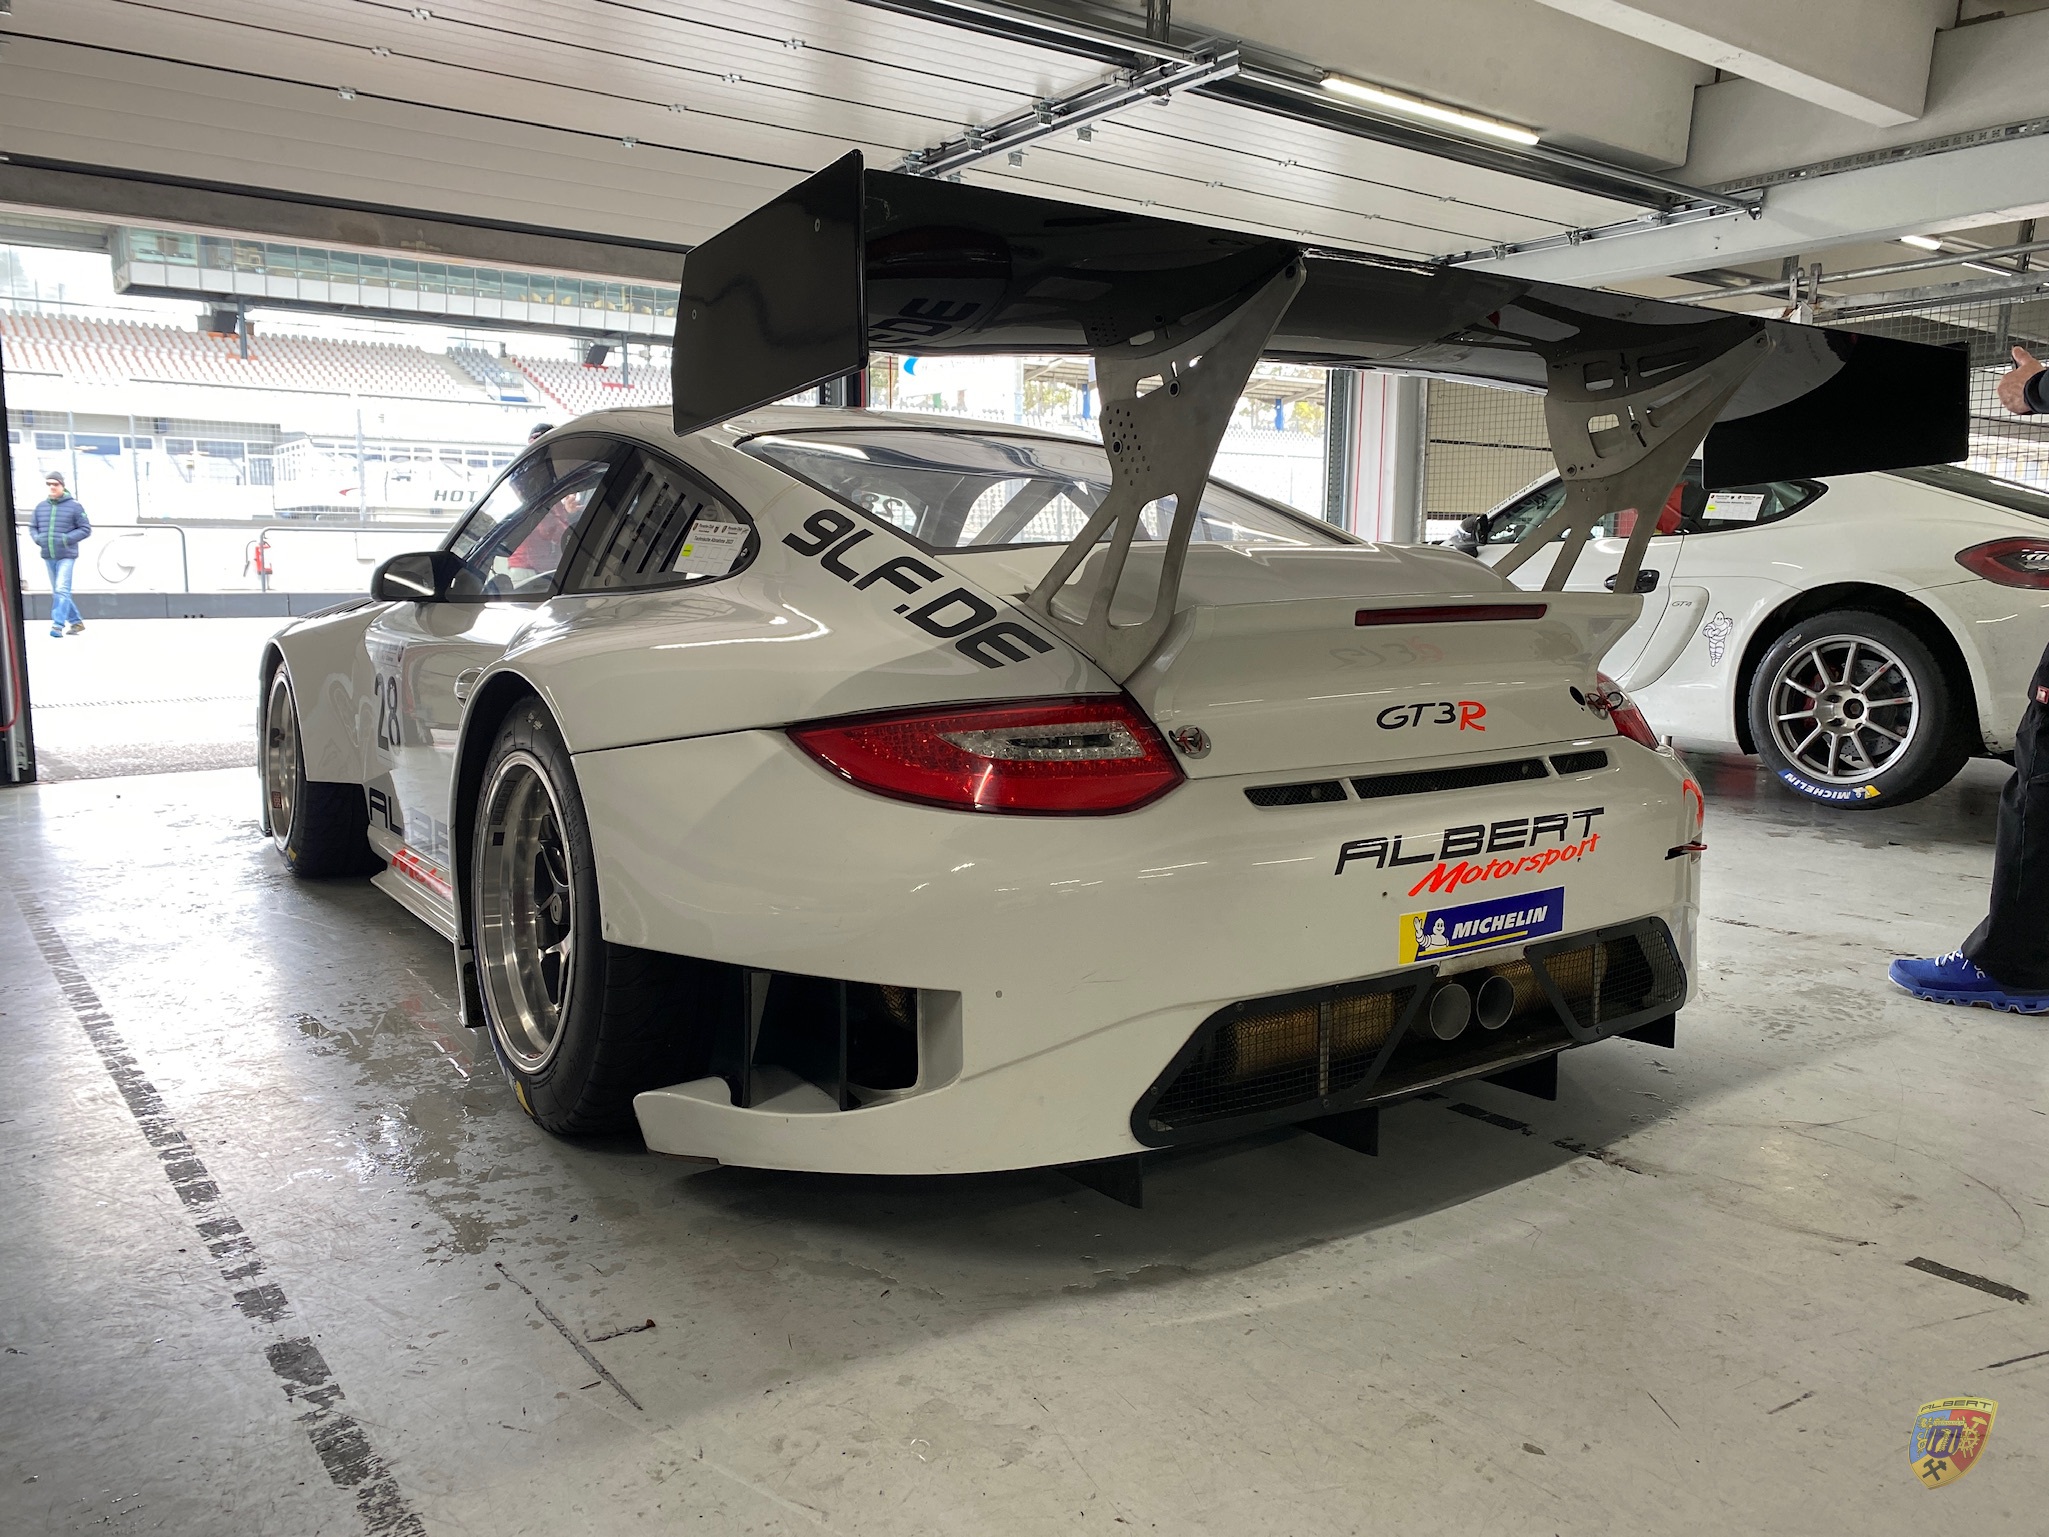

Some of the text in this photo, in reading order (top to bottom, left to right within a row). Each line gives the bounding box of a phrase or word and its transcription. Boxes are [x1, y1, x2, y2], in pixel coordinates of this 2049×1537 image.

[781, 509, 1056, 670] 9LF.DE
[1671, 600, 1693, 608] GT4
[374, 672, 402, 751] 28
[1376, 700, 1487, 732] GT3R
[1784, 771, 1852, 800] MICHELIN
[1334, 806, 1605, 876] ALBERT
[1407, 833, 1601, 897] Motorsport
[1451, 905, 1548, 940] MICHELIN
